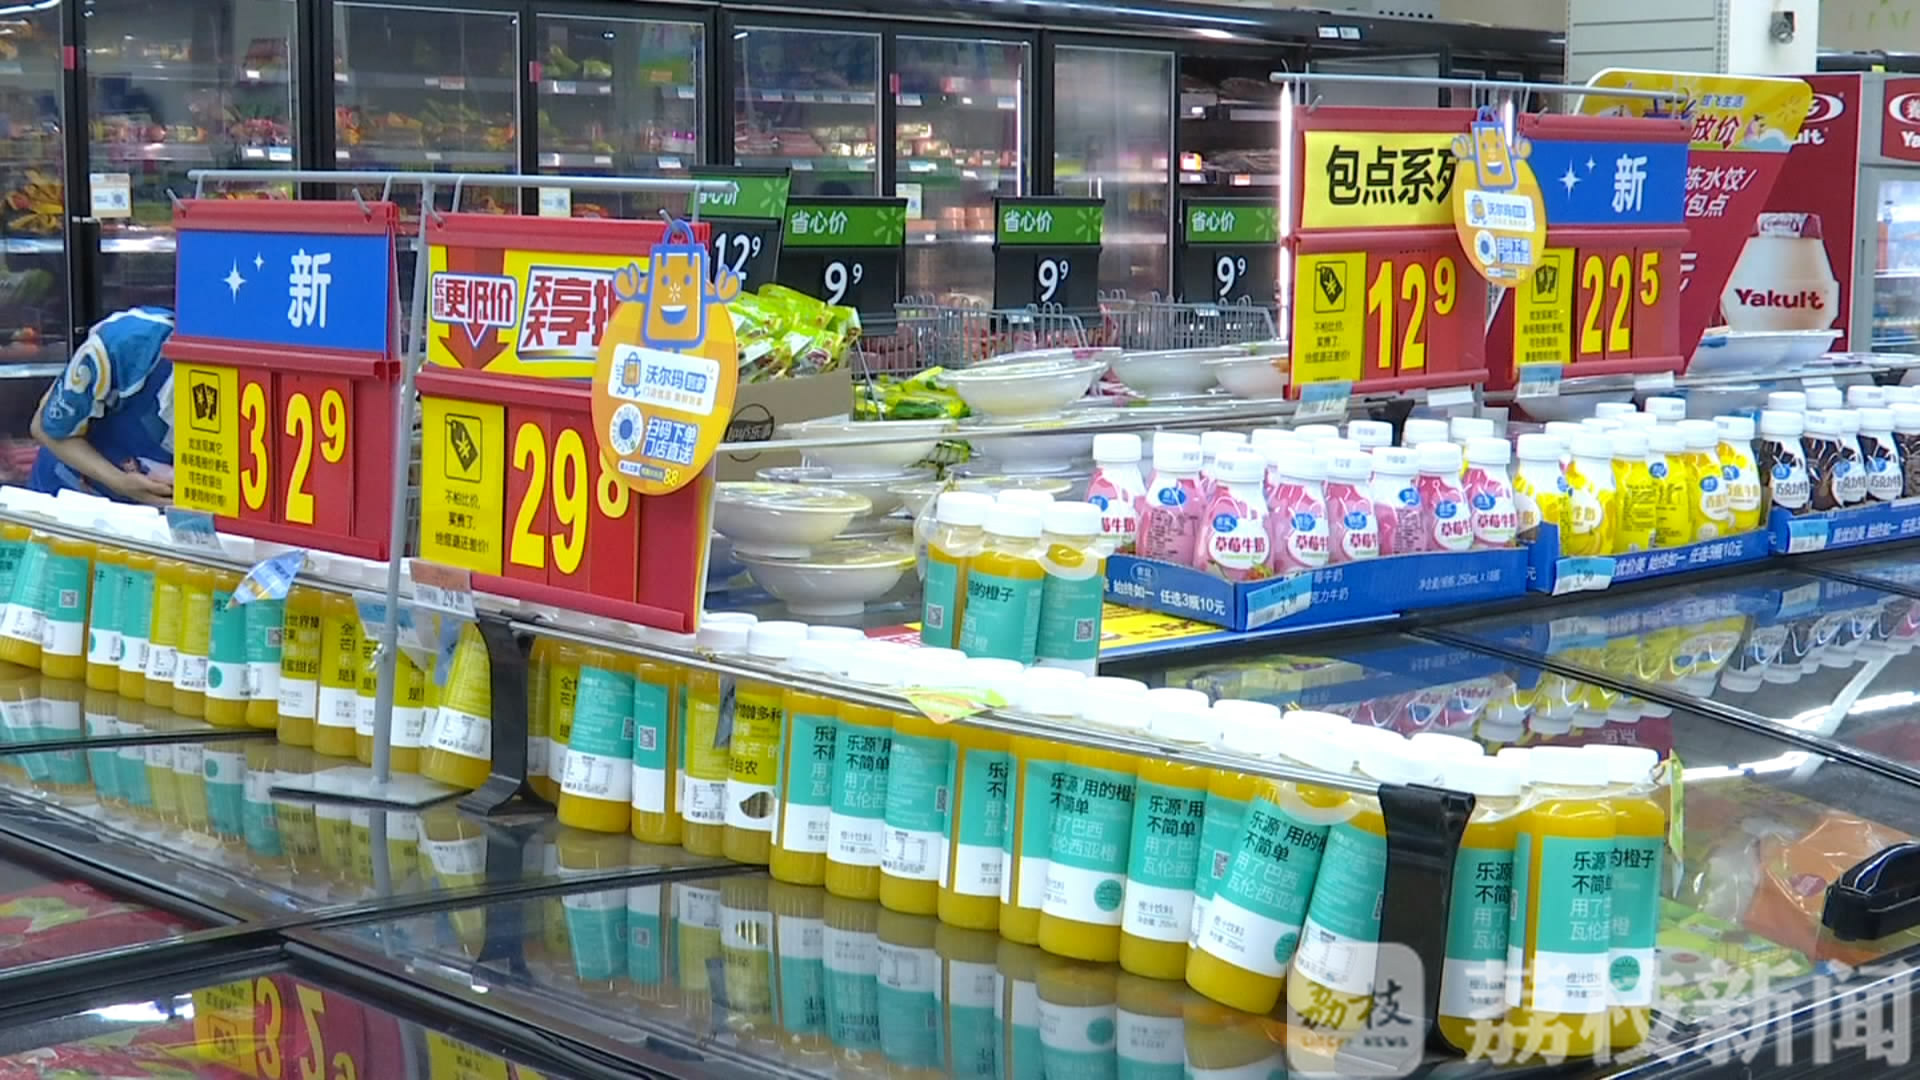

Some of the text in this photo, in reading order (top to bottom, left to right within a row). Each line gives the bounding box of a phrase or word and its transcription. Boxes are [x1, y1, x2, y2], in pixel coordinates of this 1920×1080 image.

[1612, 154, 1647, 213] 新
[791, 210, 848, 235] 省心价
[1004, 209, 1053, 233] 省心价
[1191, 210, 1236, 233] 省心价
[287, 248, 332, 329] 新
[1735, 288, 1825, 310] Yakult
[445, 279, 513, 323] 更低价
[645, 364, 685, 390] 沃尔玛
[1215, 536, 1265, 553] 草莓牛奶
[1160, 589, 1226, 616] 任选3瓶10元
[846, 752, 891, 772] 不简单
[1050, 792, 1089, 815] 不简单
[1147, 814, 1196, 838] 不简单
[1243, 830, 1290, 862] 不简单
[1573, 851, 1606, 870] 乐源
